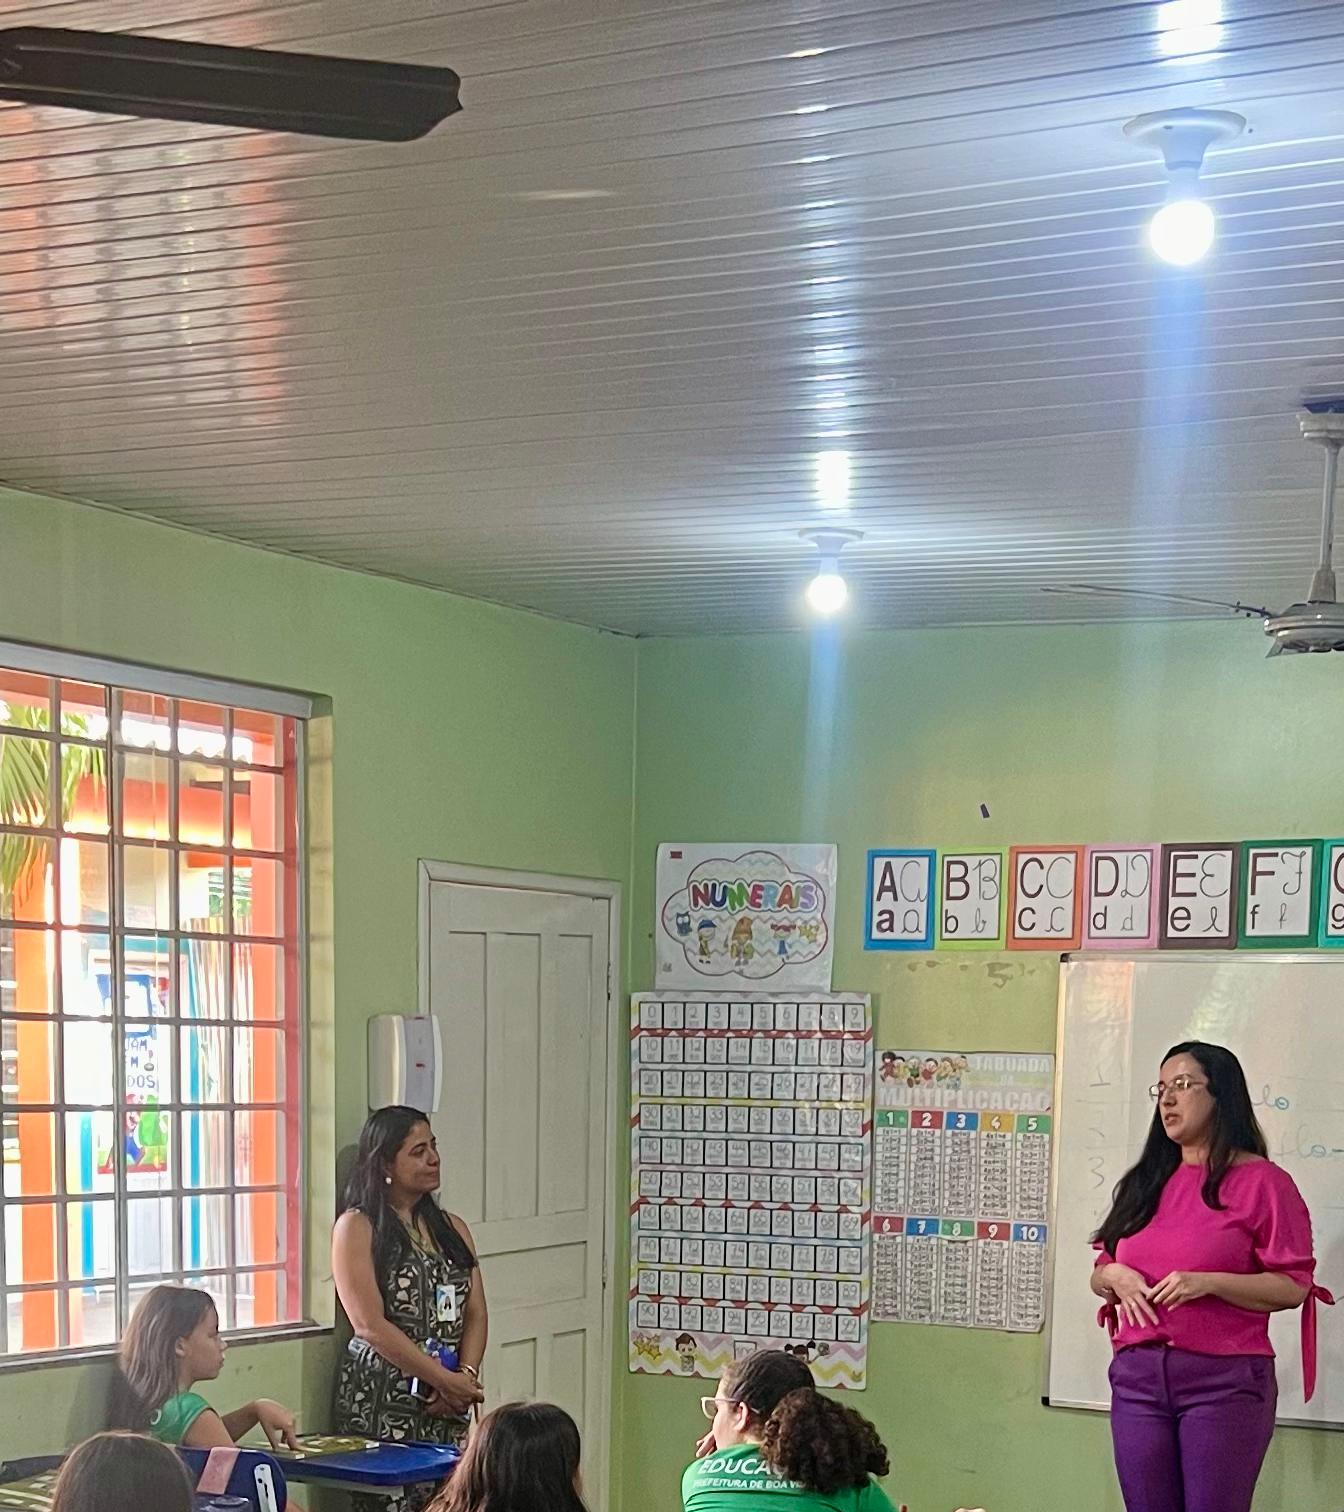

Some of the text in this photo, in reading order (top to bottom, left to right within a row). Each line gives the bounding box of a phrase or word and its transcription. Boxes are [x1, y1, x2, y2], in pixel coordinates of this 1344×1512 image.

[877, 861, 898, 901] A
[946, 861, 969, 900] B
[1020, 858, 1044, 898] C
[1095, 856, 1119, 896] D
[1172, 855, 1198, 897] E
[1251, 853, 1278, 895] F
[690, 879, 818, 913] NUMERAIS
[877, 910, 894, 932] a
[945, 910, 958, 933] b
[1018, 907, 1035, 931] c
[1093, 906, 1107, 930] d
[1171, 907, 1191, 931] e
[1250, 904, 1260, 929] f
[750, 1479, 764, 1489] DE
[766, 1480, 788, 1489] BOA
